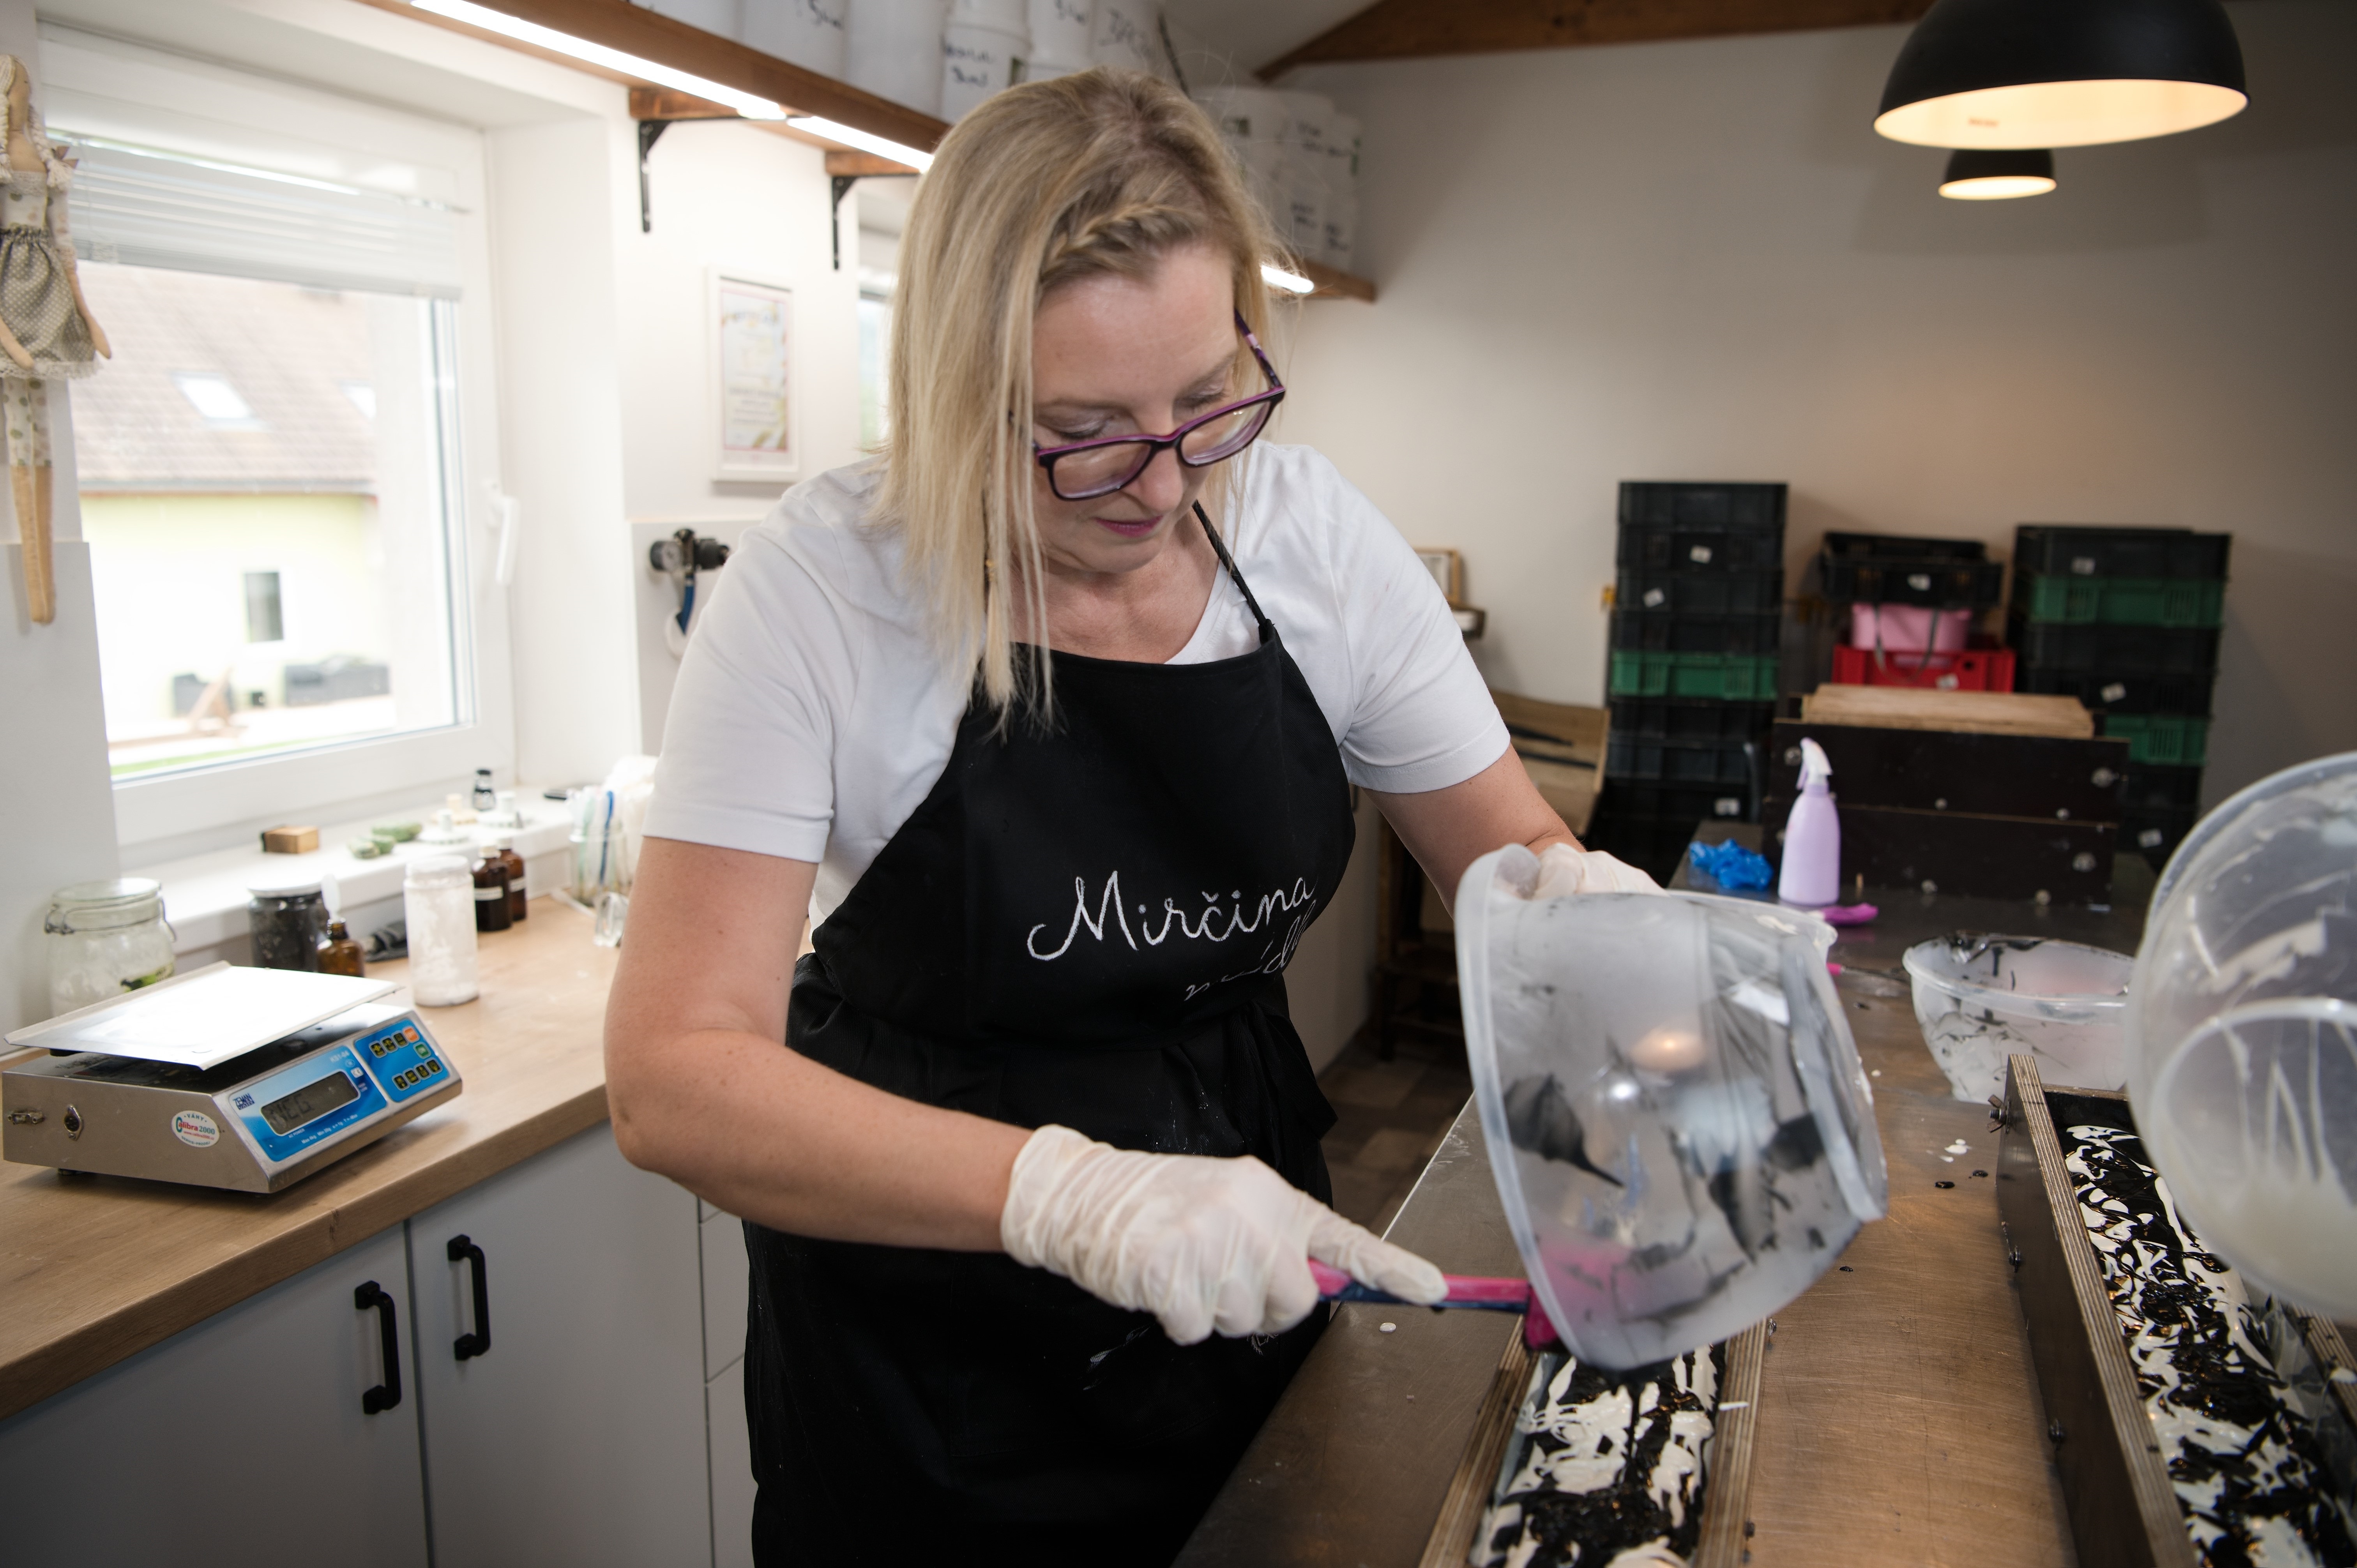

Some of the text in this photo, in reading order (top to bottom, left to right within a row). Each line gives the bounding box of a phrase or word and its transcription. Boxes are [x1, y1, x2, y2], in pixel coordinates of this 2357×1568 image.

[1028, 870, 1318, 961] Mirčina
[233, 1093, 253, 1106] ZEMAN
[176, 1117, 215, 1135] Calibra 2000
